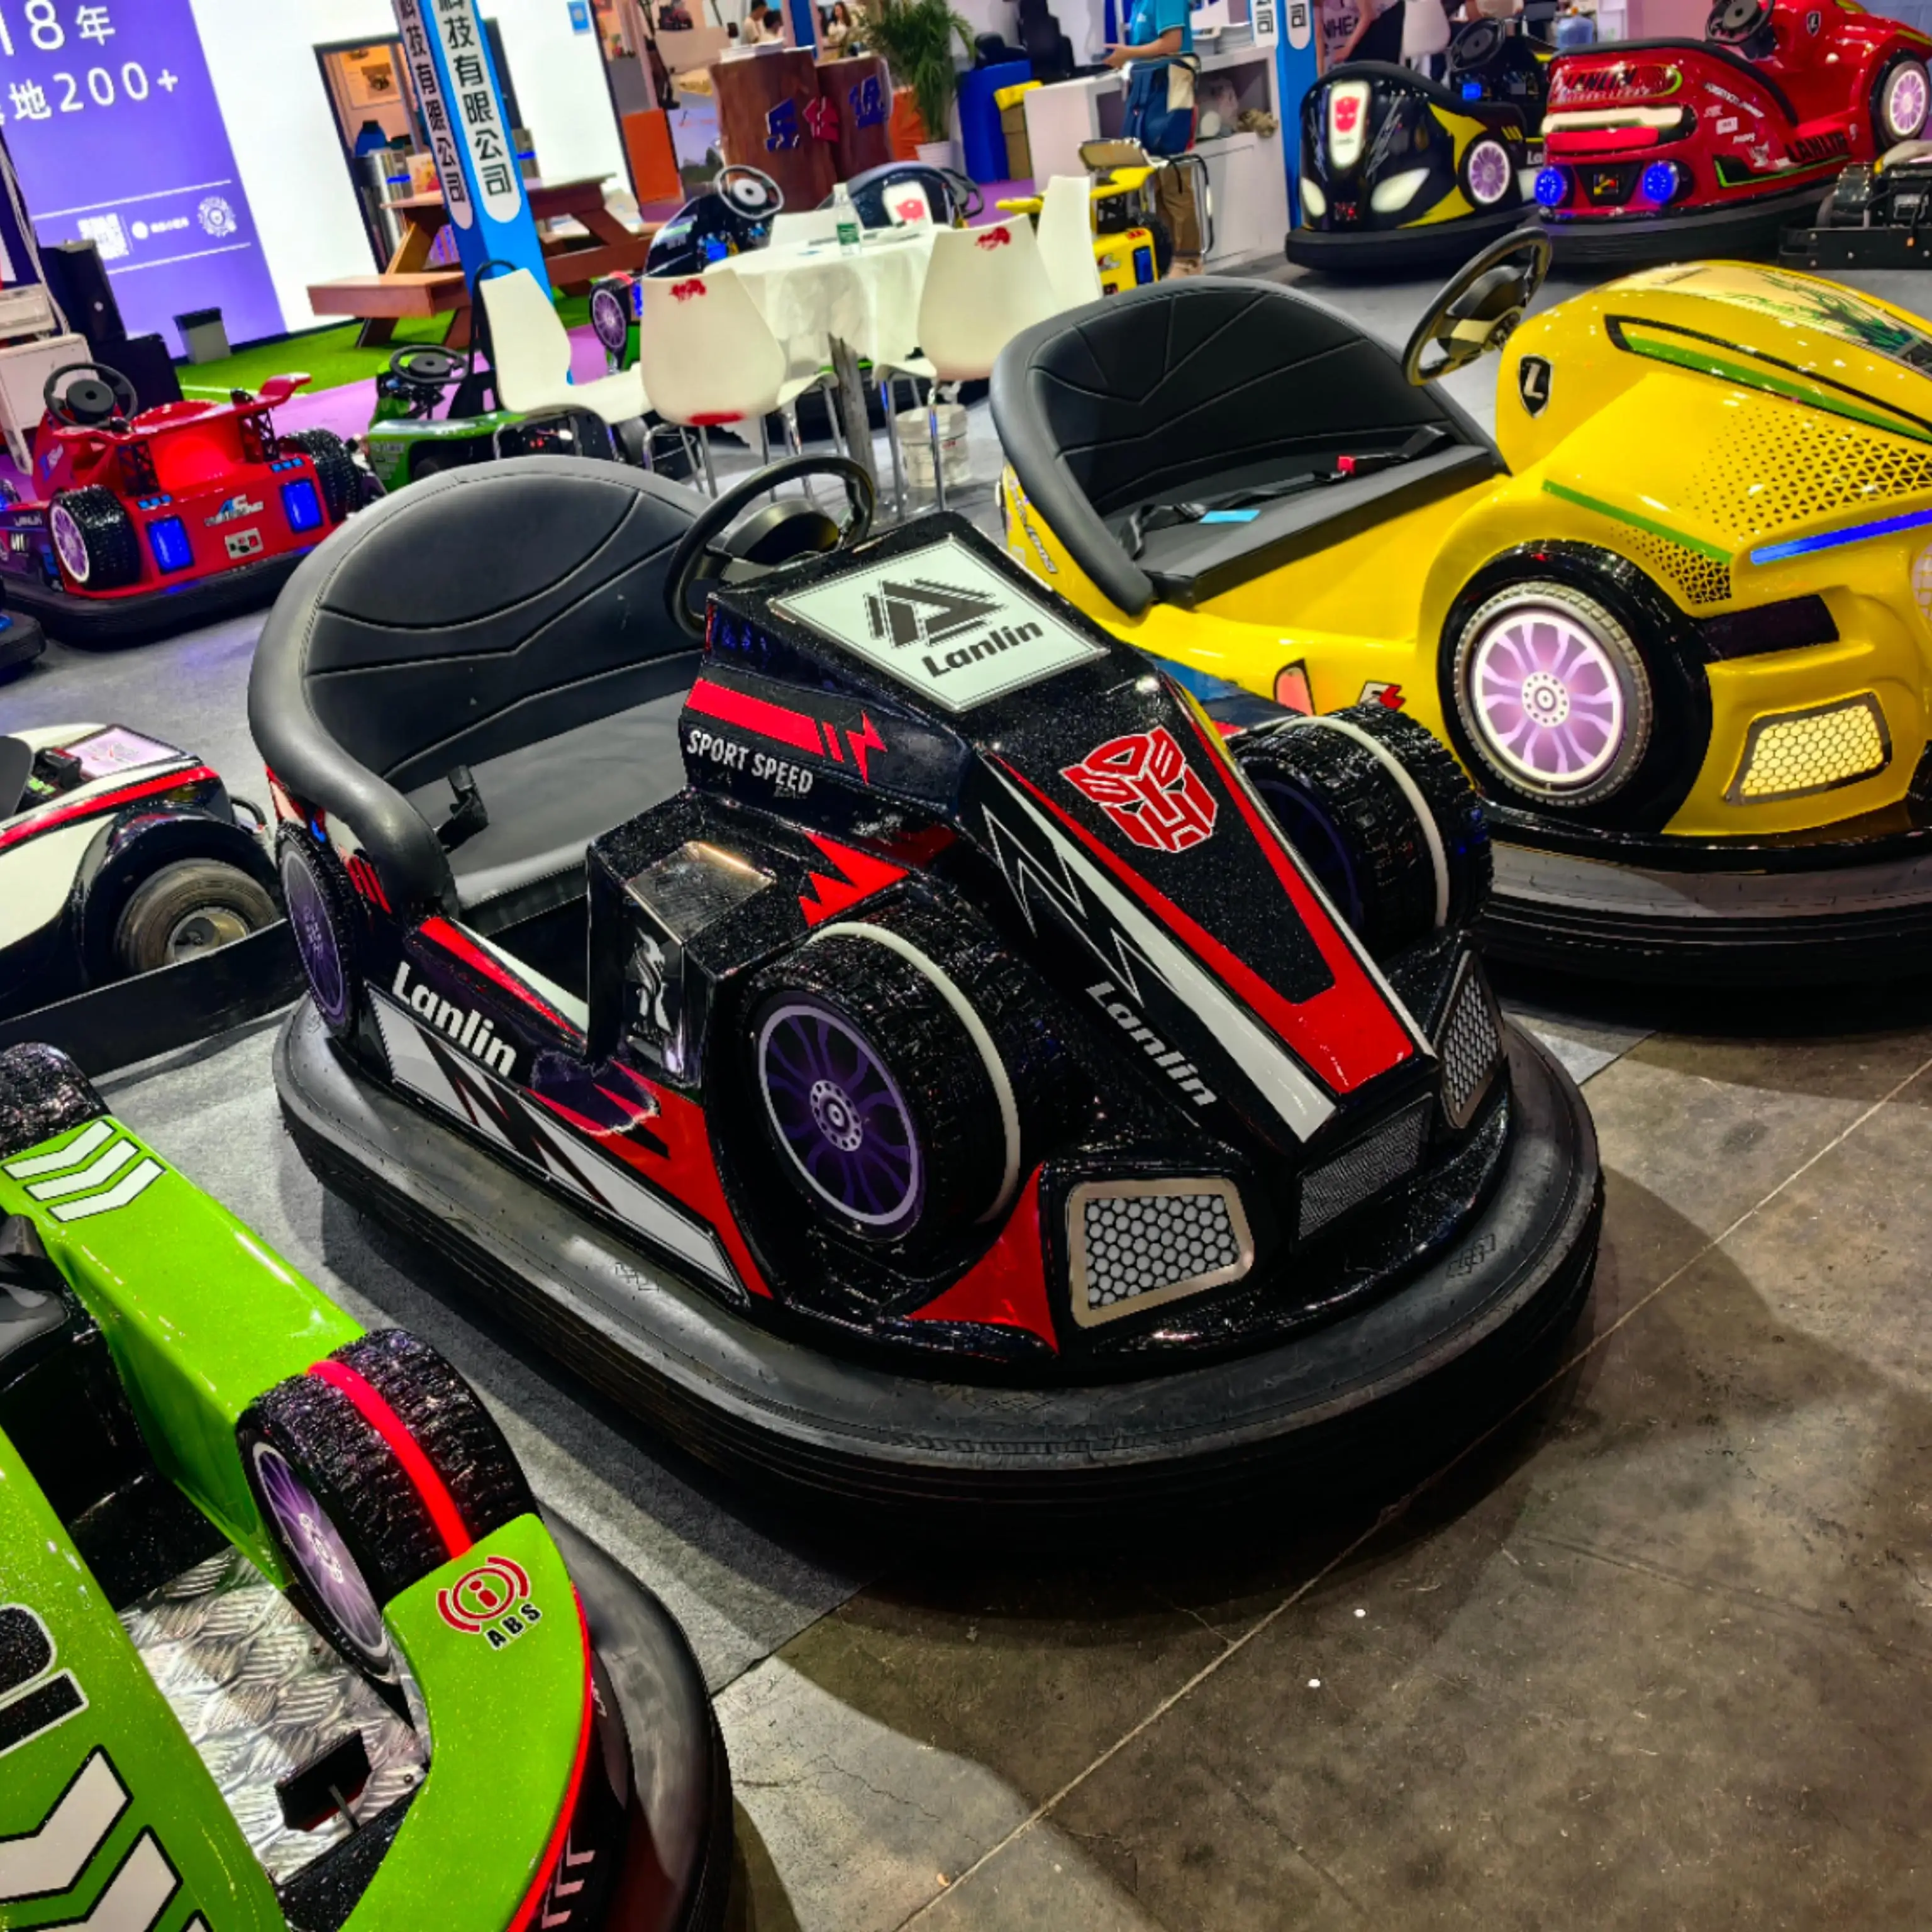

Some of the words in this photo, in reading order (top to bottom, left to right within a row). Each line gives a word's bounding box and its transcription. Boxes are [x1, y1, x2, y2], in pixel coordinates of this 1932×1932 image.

[0, 61, 179, 126] 地200+
[921, 621, 1044, 678] Lanlin
[686, 729, 750, 771] SPORT
[751, 753, 814, 794] SPEED
[392, 960, 517, 1078] Lanlin
[1084, 980, 1218, 1106] Lanlin
[484, 1602, 543, 1650] ABS
